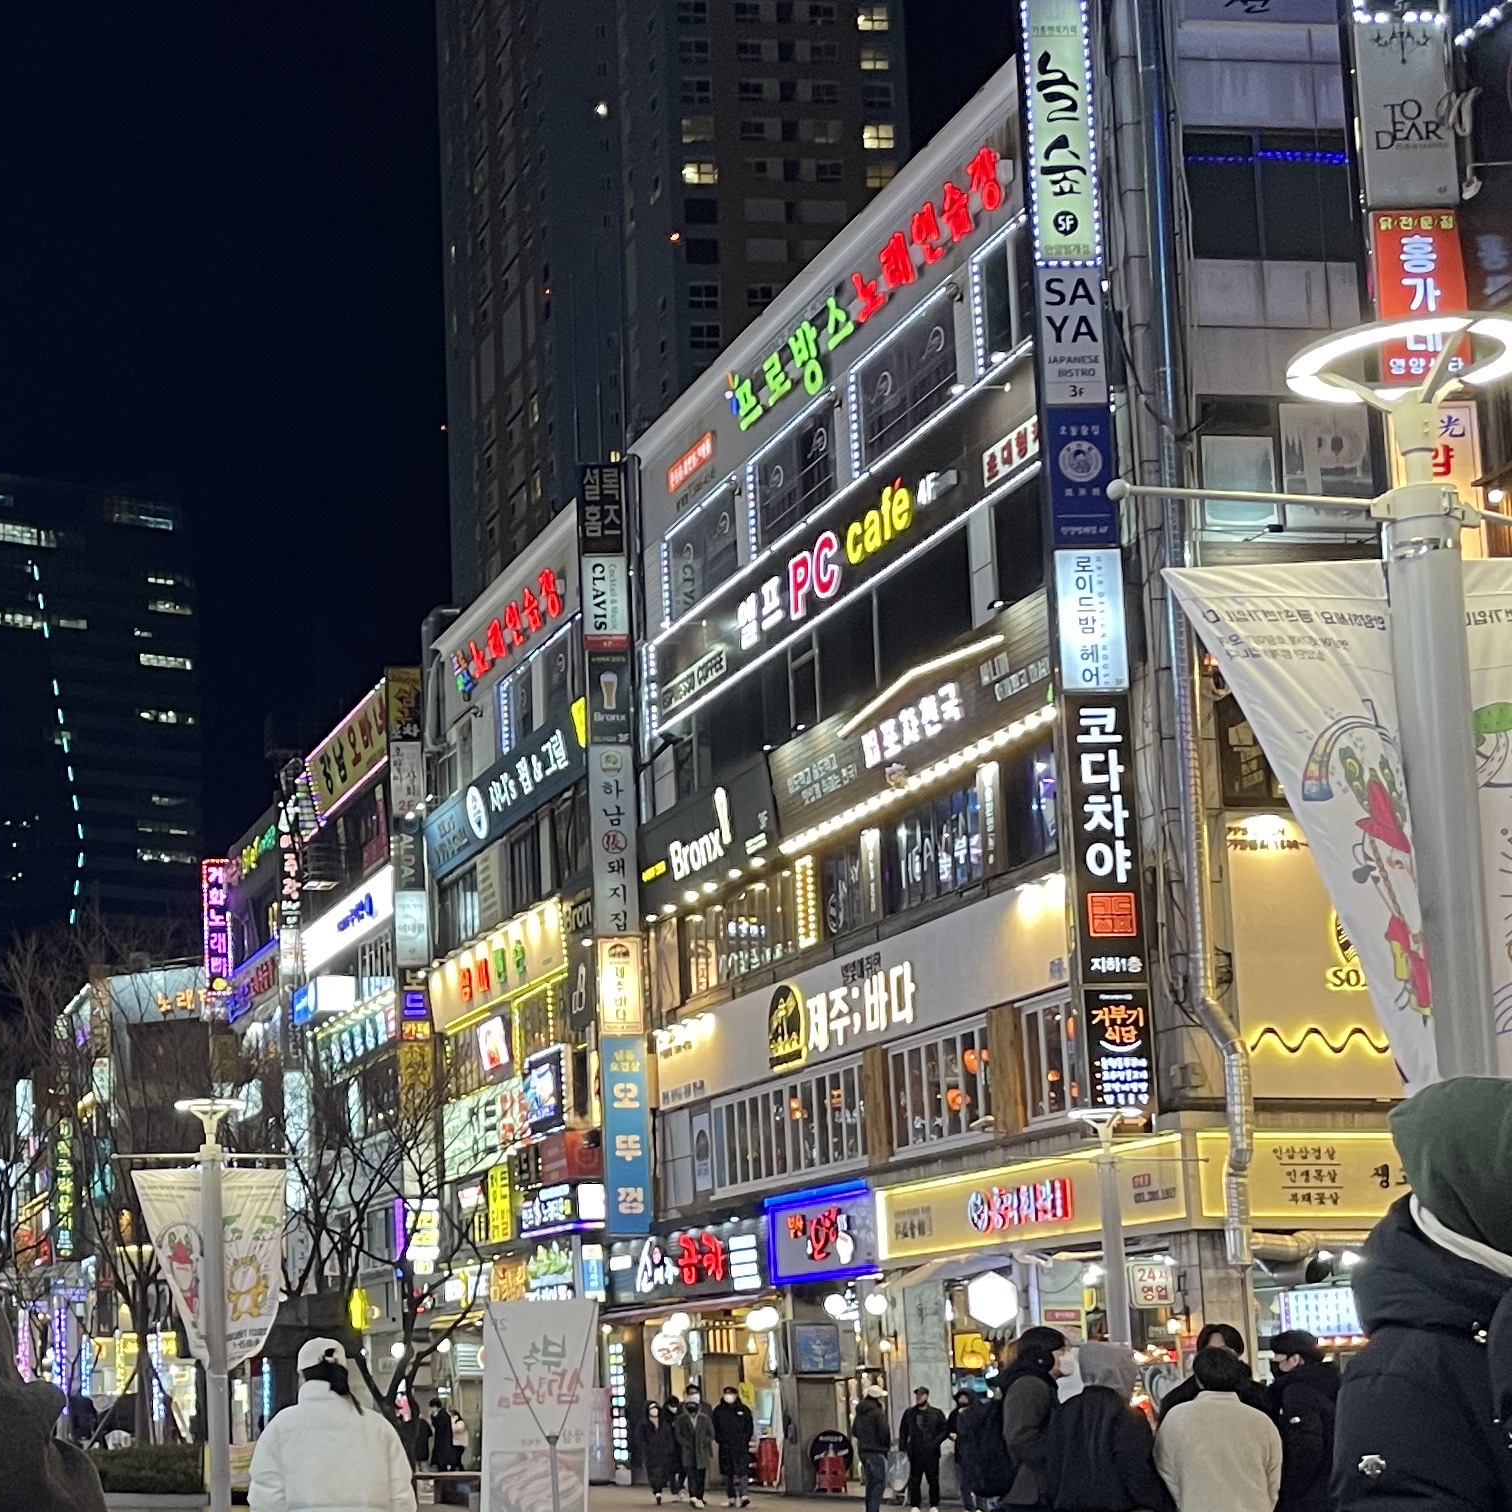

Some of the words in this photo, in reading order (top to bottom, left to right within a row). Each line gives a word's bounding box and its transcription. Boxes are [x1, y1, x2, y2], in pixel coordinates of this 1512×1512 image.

[1382, 98, 1422, 123] TO
[1375, 120, 1445, 151] DEAR
[732, 296, 856, 432] 프로방스
[850, 145, 1004, 323] 노래연습장
[1045, 277, 1096, 306] SA
[1046, 314, 1099, 344] YA
[1046, 354, 1101, 366] JAPANESE
[1057, 367, 1097, 378] BISTRO
[1068, 384, 1086, 399] 3F
[583, 467, 621, 502] 셜록
[584, 504, 622, 538] 홈즈
[787, 529, 842, 622] PC
[844, 476, 914, 566] café
[916, 471, 943, 506] 4F
[591, 562, 608, 632] CLAVIS
[1073, 555, 1097, 635] 로이드밤
[468, 567, 563, 680] 노래연습장
[1080, 643, 1100, 687] 헤어
[593, 711, 627, 723] Bronx
[1075, 706, 1133, 883] 코다차야
[669, 827, 725, 882] Bronx
[1090, 956, 1143, 974] 지하1층
[1332, 966, 1368, 989] SO
[1090, 1004, 1144, 1028] 거부기
[1104, 1025, 1139, 1043] 식당
[1137, 1267, 1169, 1283] 24시
[1141, 1285, 1169, 1302] 영업
